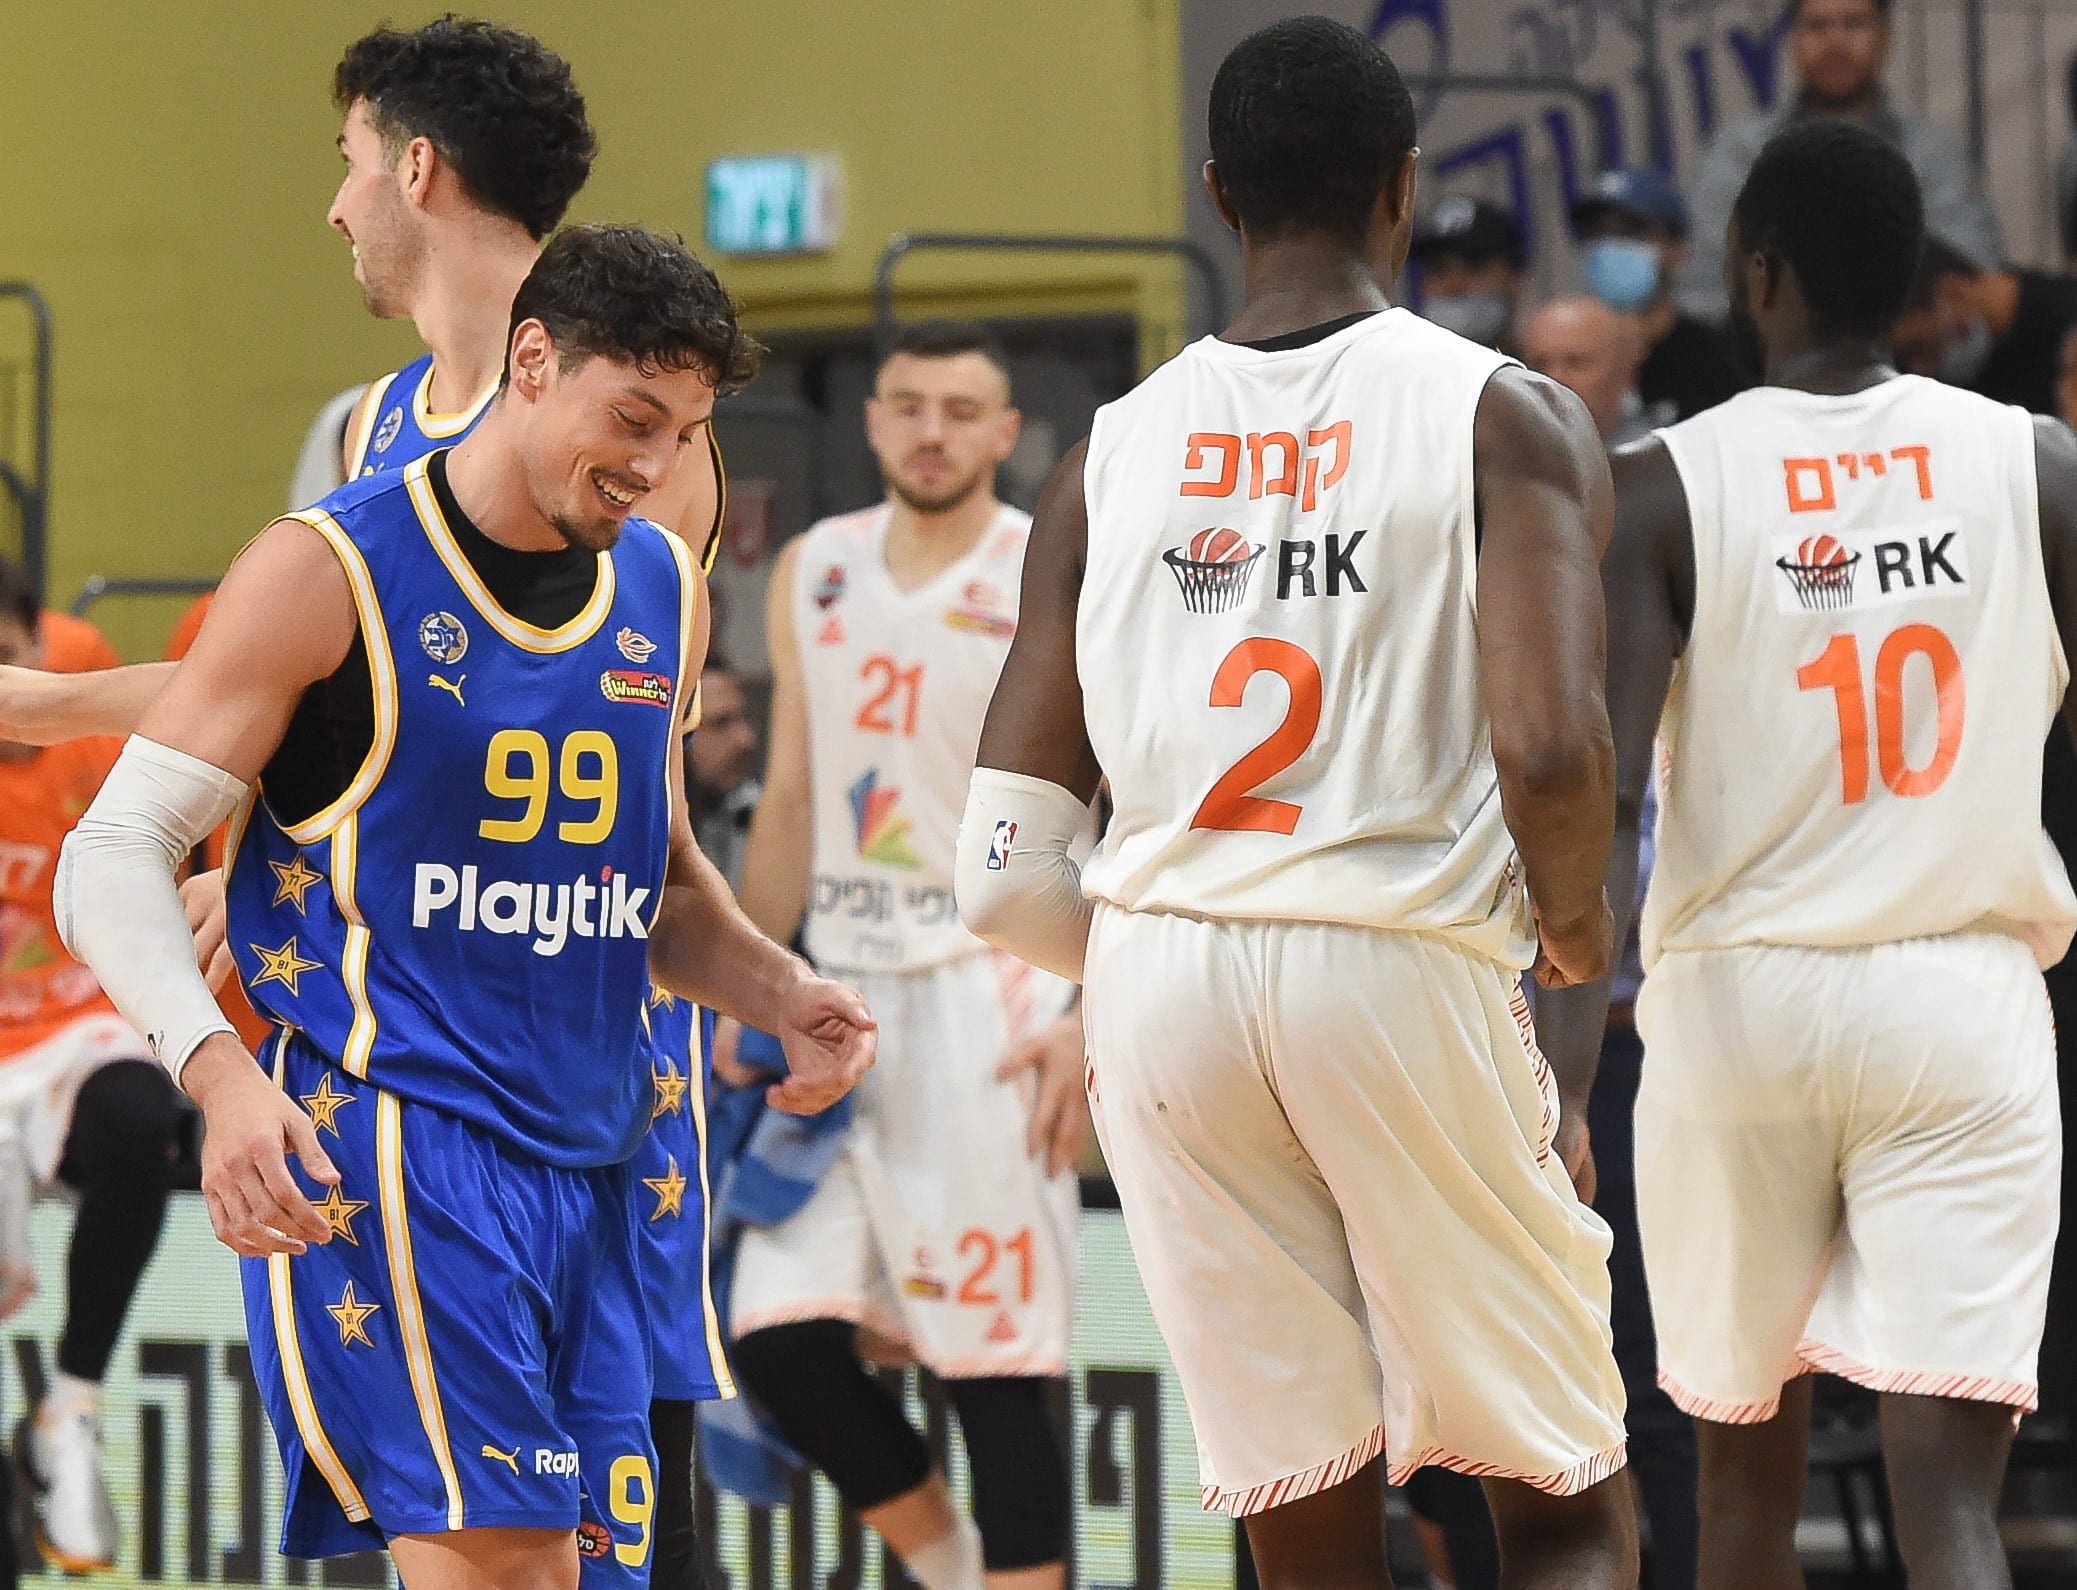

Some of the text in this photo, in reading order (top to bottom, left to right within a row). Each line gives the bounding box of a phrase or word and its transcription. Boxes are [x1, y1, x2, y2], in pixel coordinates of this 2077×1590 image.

[1180, 422, 1350, 513] קמפ
[1783, 446, 1932, 512] דיים
[1276, 529, 1369, 600] RK
[1874, 532, 1963, 594] RK
[609, 679, 659, 699] Winner
[854, 654, 925, 738] 21
[1797, 623, 1965, 805] 10
[1189, 636, 1323, 836] 2
[479, 730, 619, 845] 99
[328, 1208, 340, 1221] 81
[956, 1227, 1035, 1307] 21
[609, 1455, 655, 1567] 9
